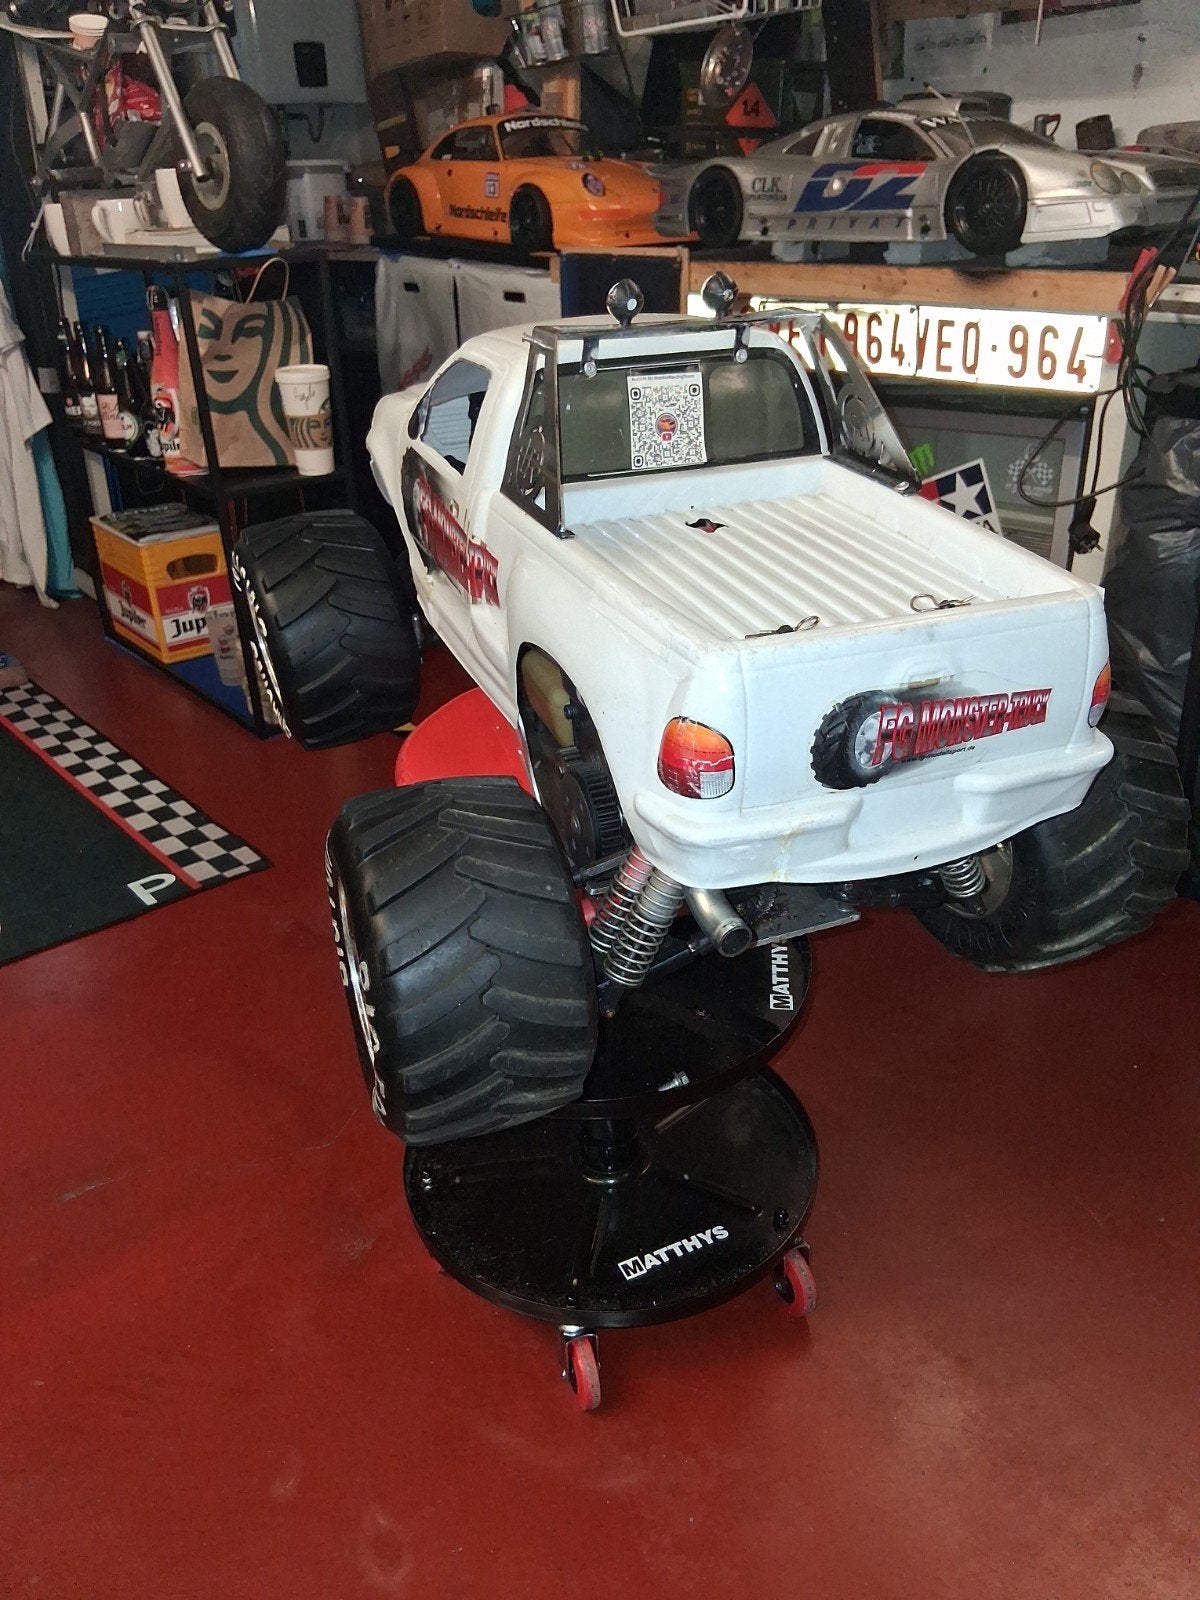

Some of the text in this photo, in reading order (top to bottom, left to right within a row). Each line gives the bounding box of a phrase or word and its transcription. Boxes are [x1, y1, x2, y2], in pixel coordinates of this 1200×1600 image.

[872, 702, 915, 766] FG
[127, 873, 176, 906] P
[769, 938, 794, 1011] MATTHY
[618, 1226, 729, 1281] MATTHYS
